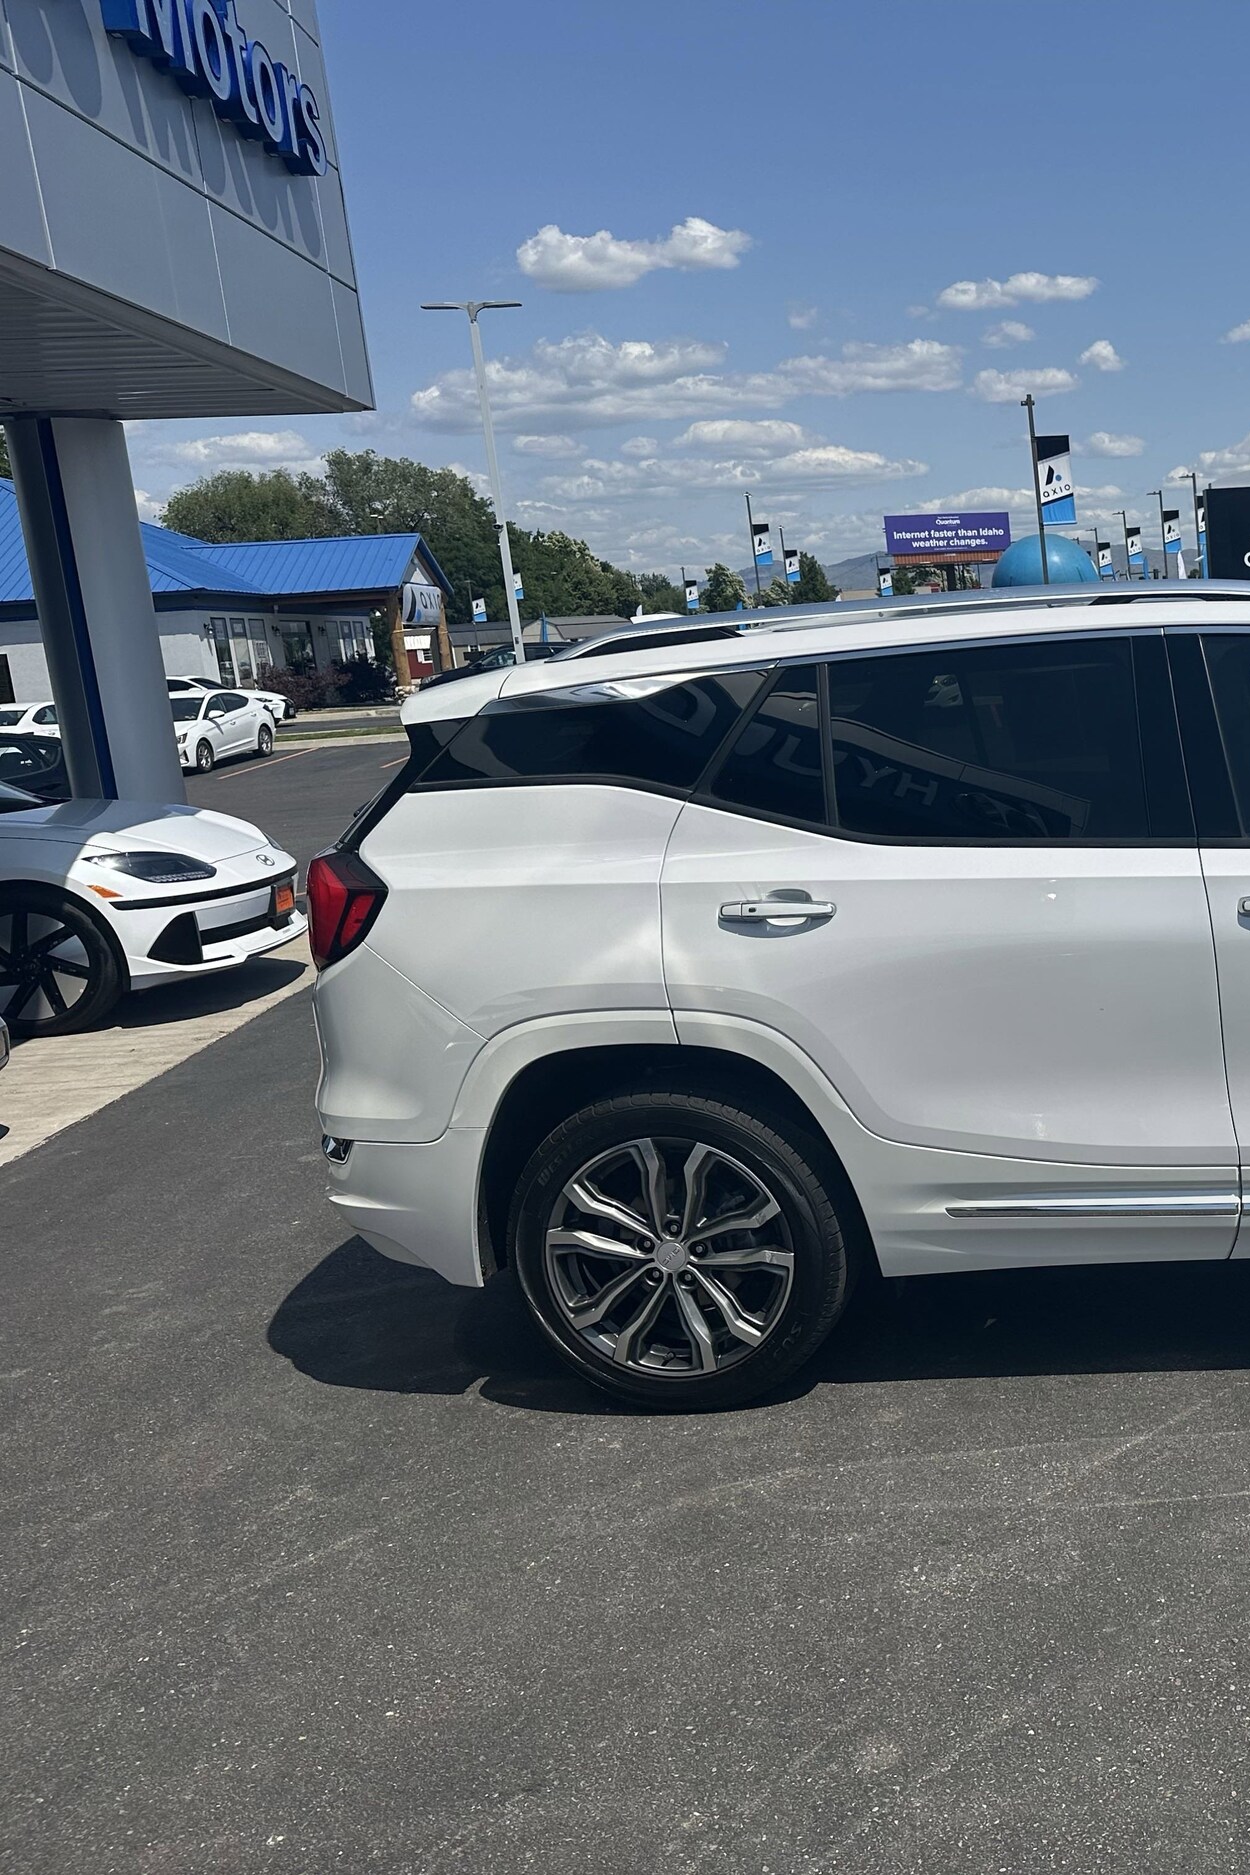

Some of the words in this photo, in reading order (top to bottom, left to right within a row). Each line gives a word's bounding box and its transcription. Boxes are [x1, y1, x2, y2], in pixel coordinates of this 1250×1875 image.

[893, 531, 930, 540] Internet
[930, 529, 956, 540] faster
[957, 528, 978, 537] than
[979, 527, 1004, 537] Idaho
[911, 538, 947, 548] weather
[949, 537, 989, 548] changes.
